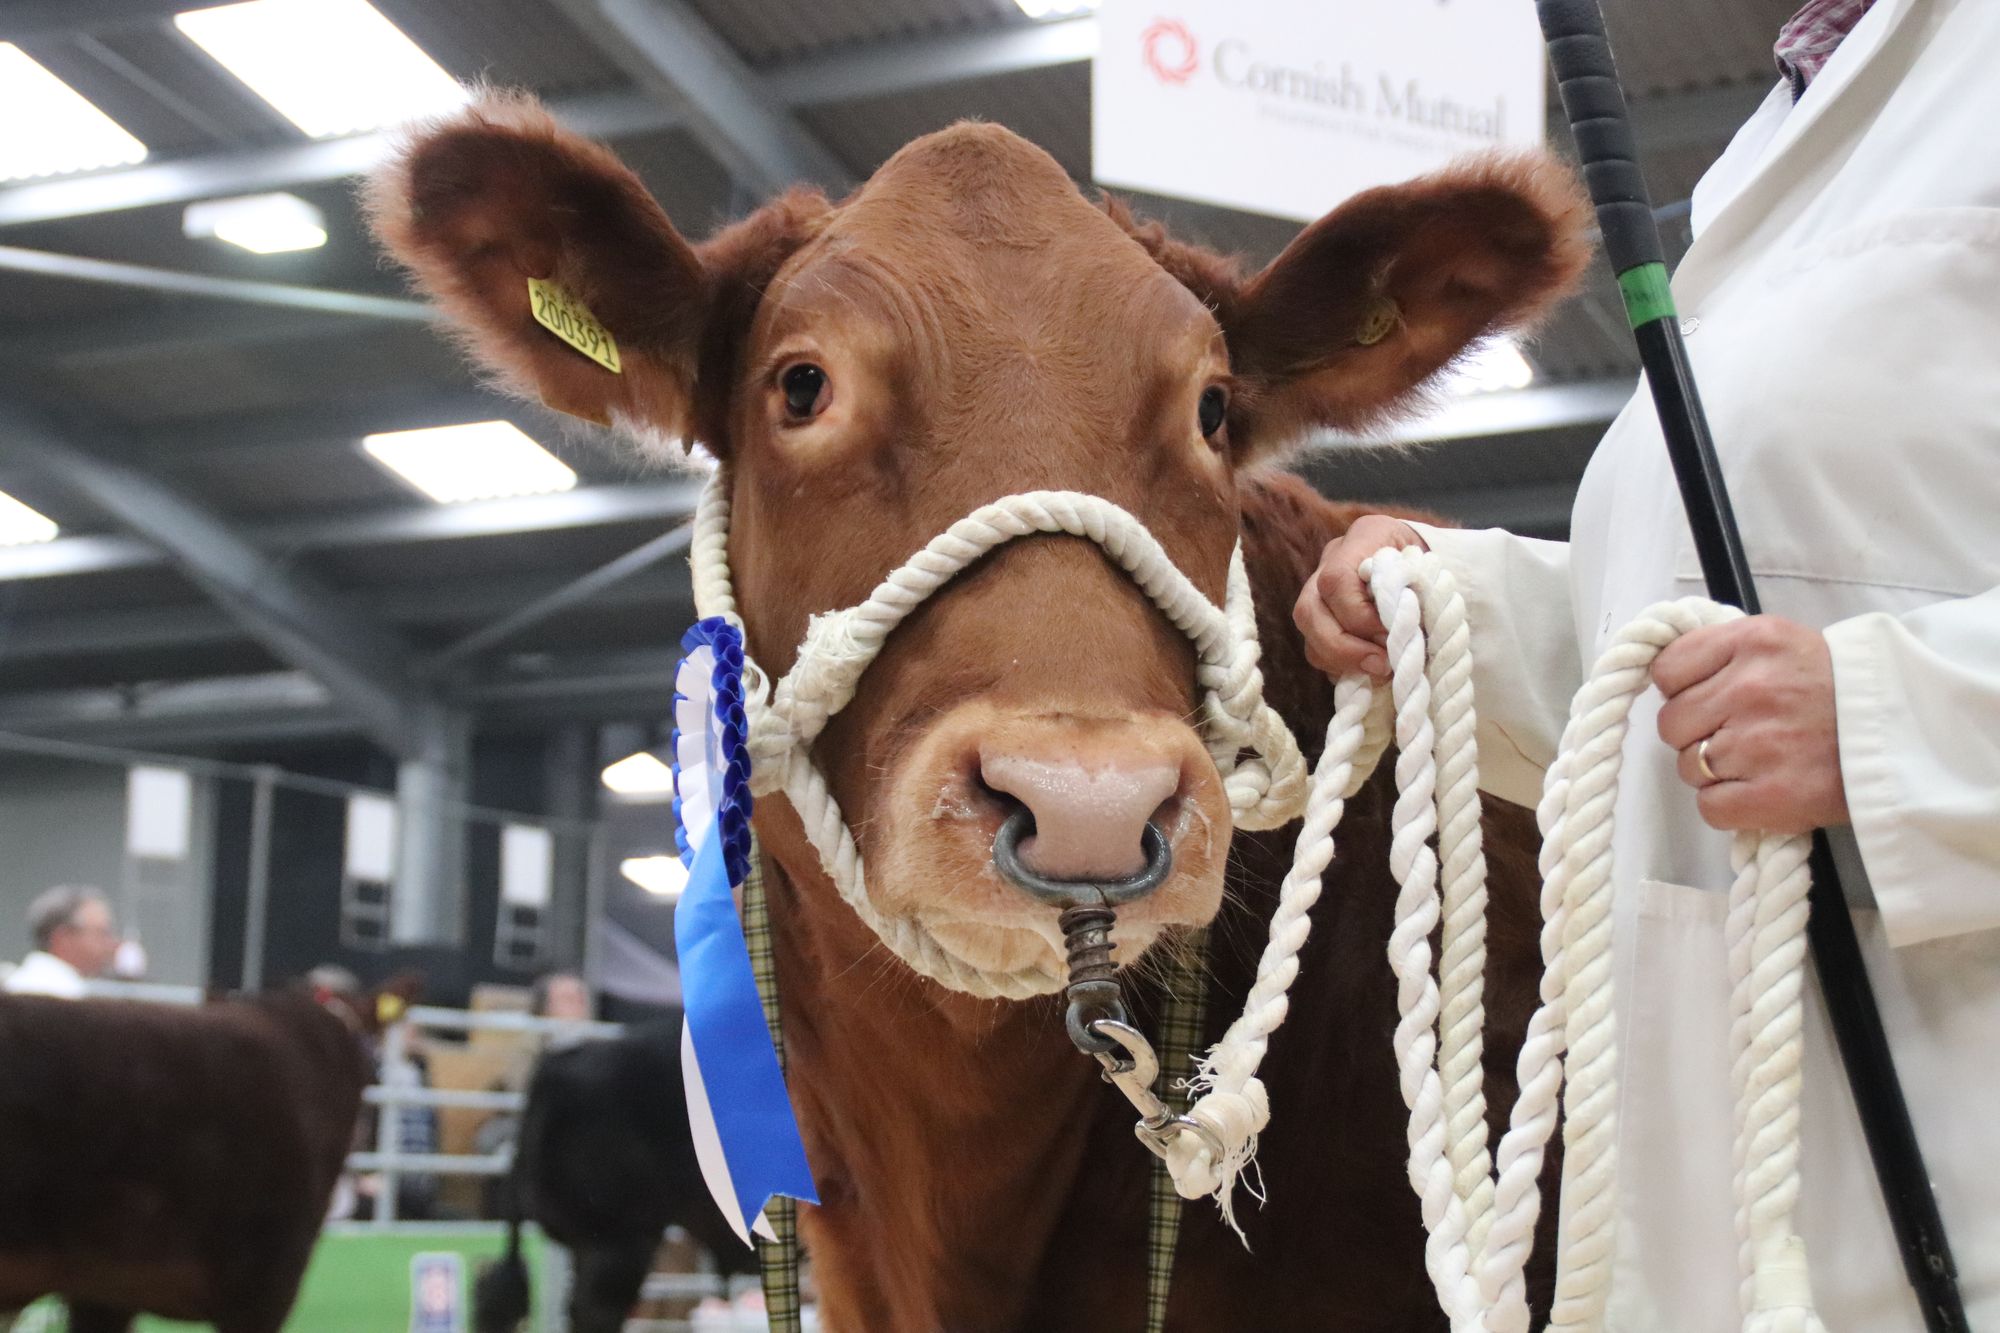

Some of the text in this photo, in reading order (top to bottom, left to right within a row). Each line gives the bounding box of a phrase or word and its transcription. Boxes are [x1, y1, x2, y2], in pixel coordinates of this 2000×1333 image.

[1212, 38, 1366, 113] Cornish
[1374, 70, 1508, 139] Mutual
[535, 289, 616, 367] 200391
